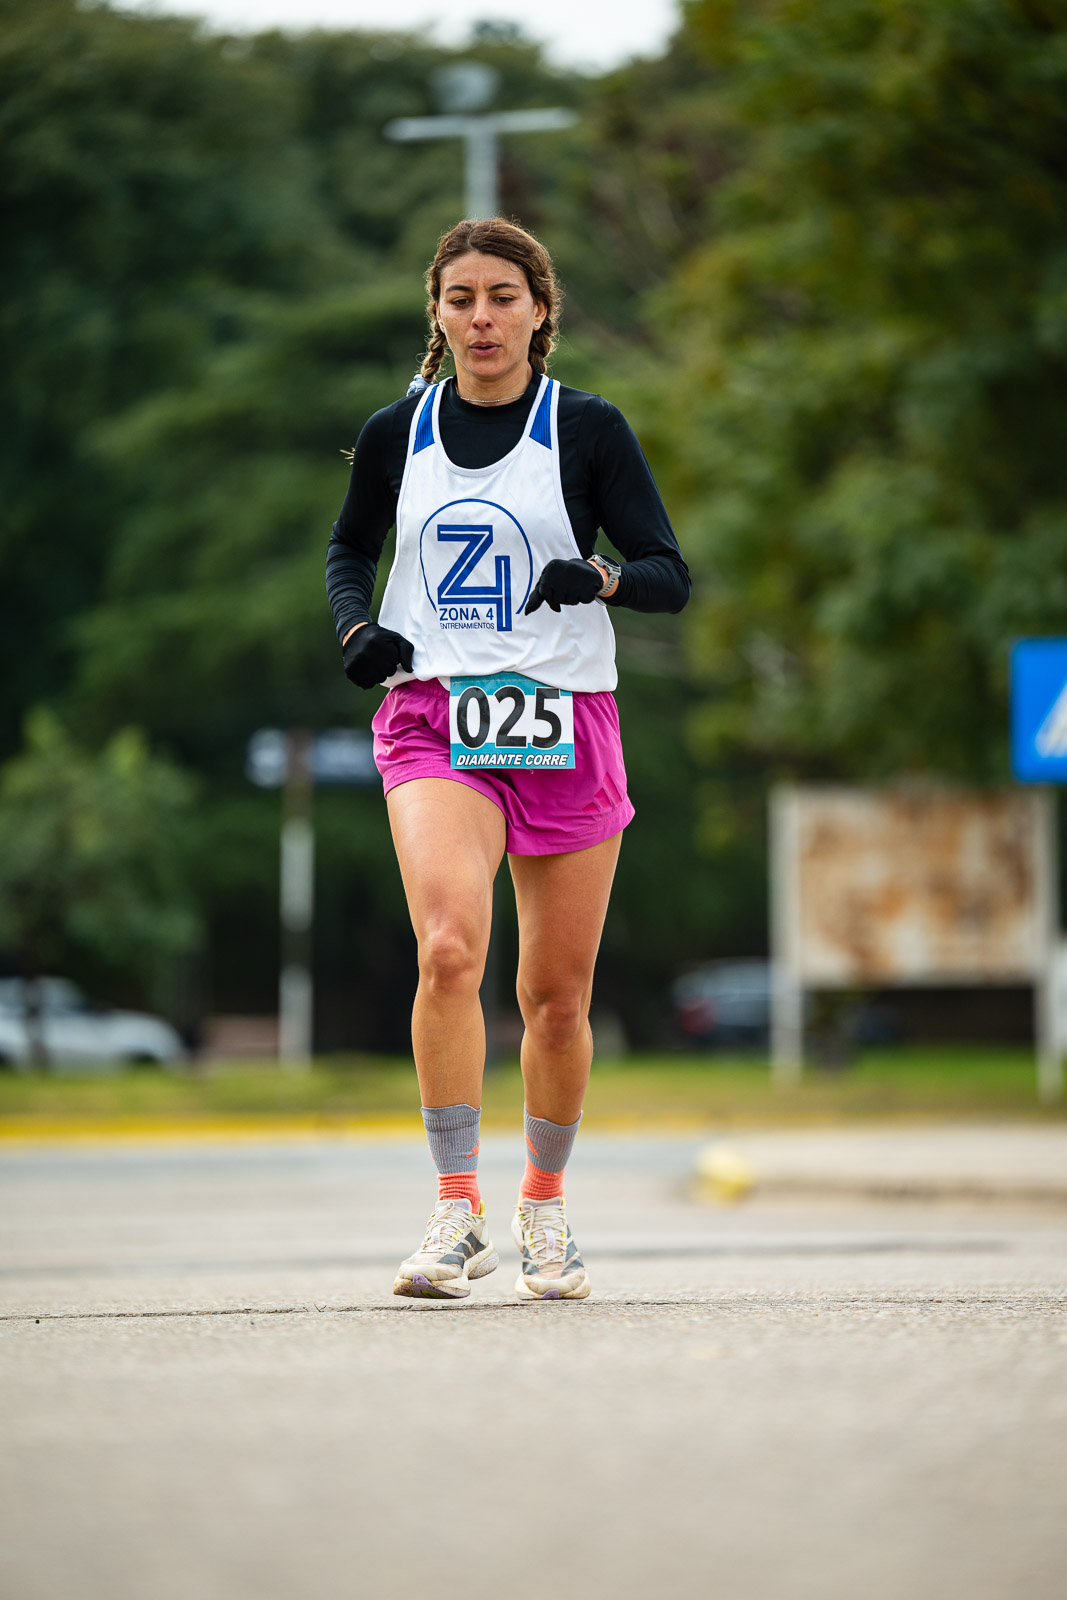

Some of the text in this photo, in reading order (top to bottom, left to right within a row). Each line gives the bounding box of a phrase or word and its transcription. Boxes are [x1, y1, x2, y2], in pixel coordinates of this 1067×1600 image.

[439, 607, 494, 621] ZONA 4
[440, 622, 495, 630] ENTRENAMIENTOS
[456, 685, 562, 750] 025
[456, 753, 569, 766] DIAMANTE CORRE
